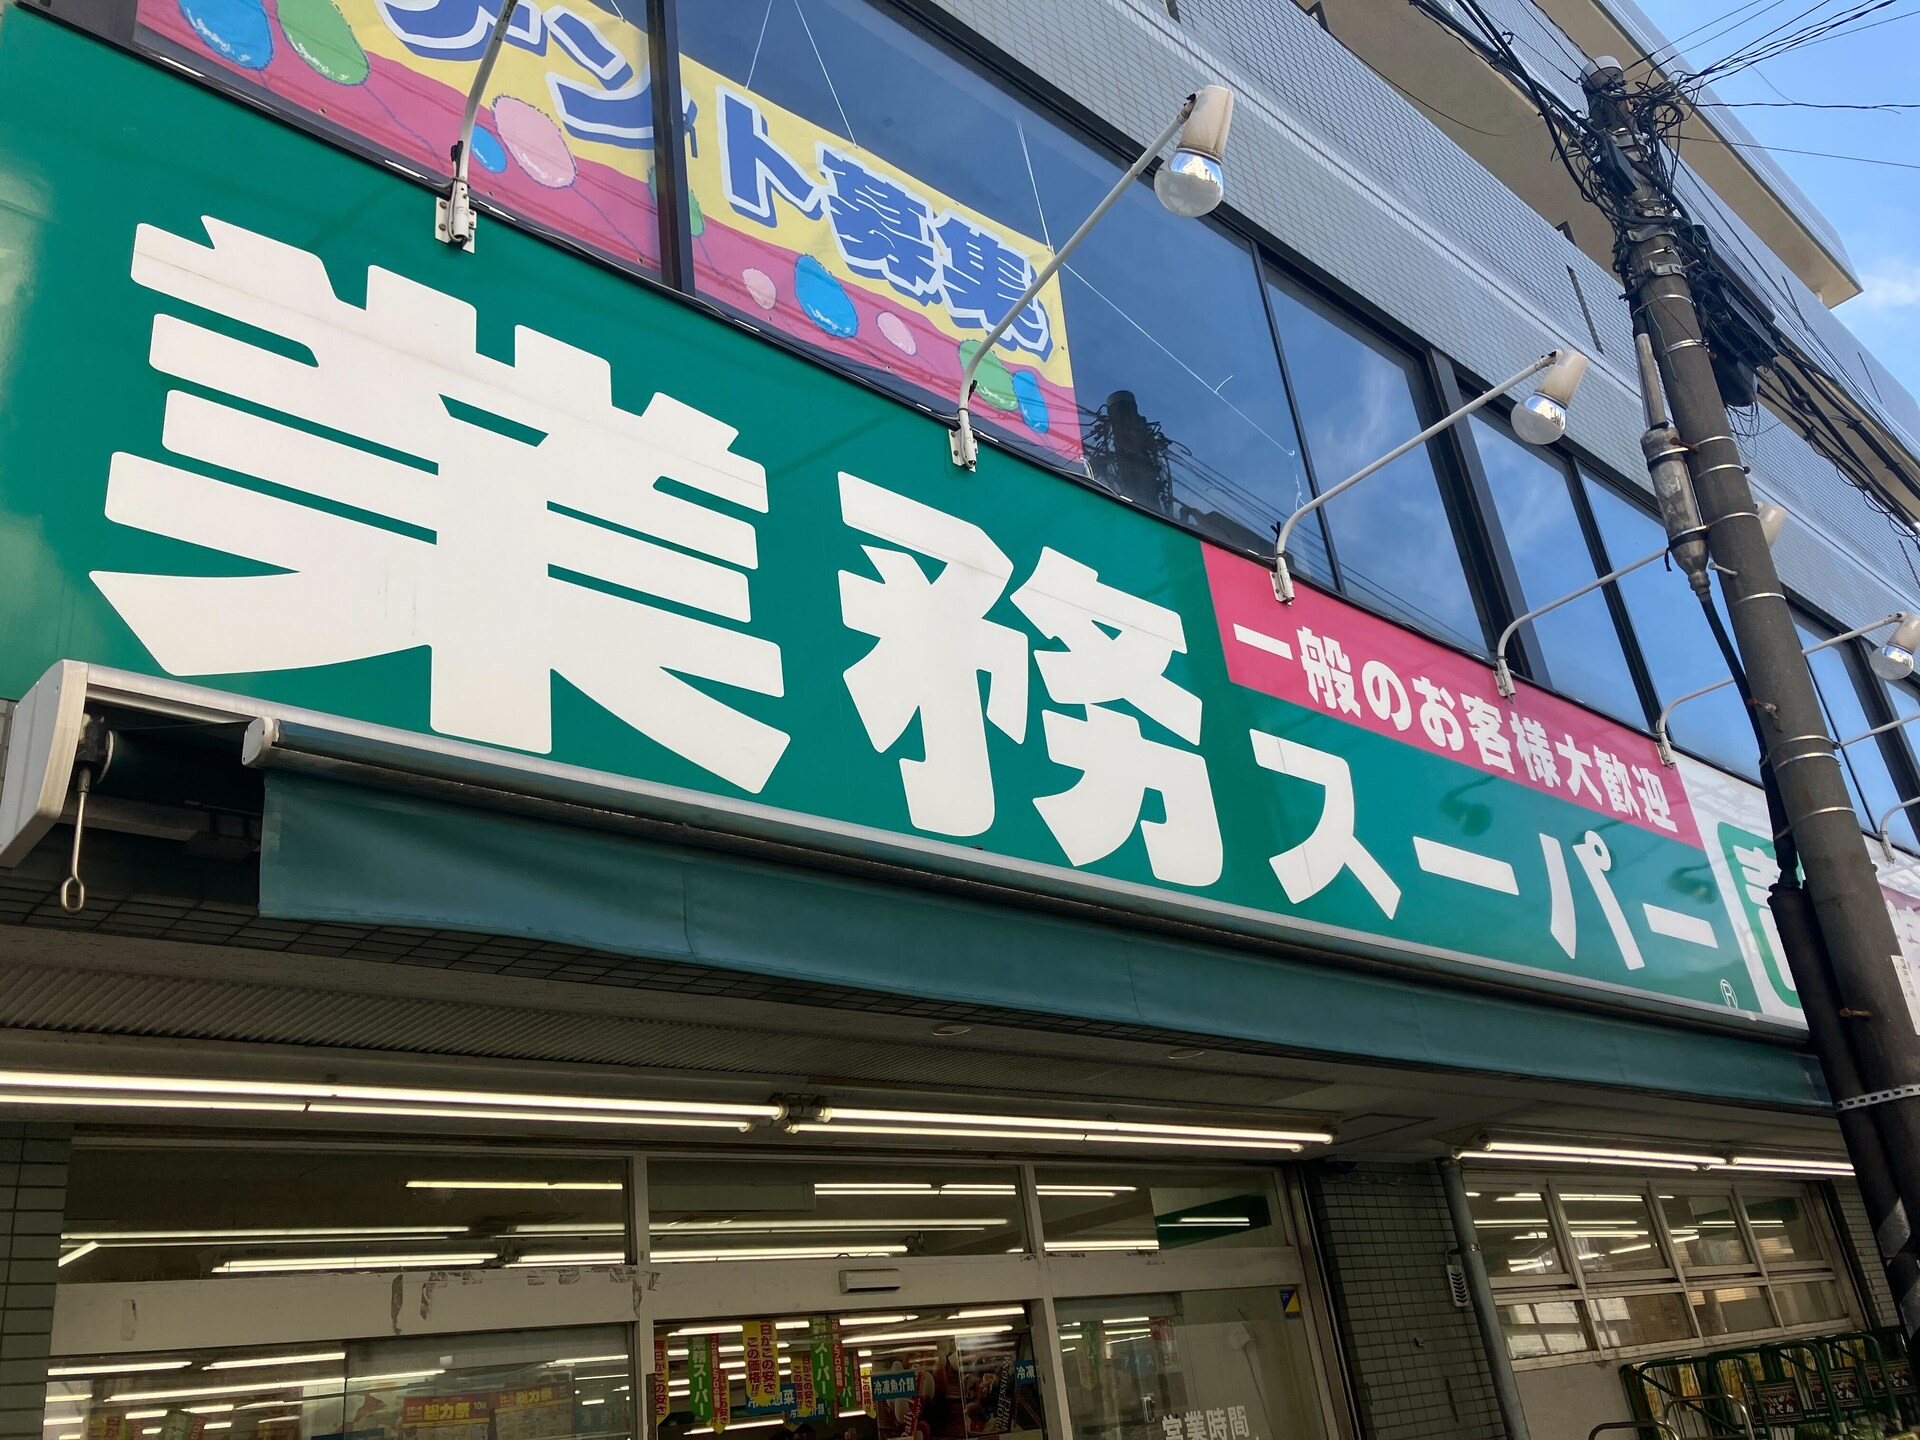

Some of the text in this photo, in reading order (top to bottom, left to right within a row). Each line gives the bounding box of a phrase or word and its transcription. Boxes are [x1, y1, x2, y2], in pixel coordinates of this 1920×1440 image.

[88, 215, 1717, 969] 業務スーパー
[1234, 623, 1678, 834] 一般のお客様大歓迎
[691, 1337, 709, 1416] 業務スーパー
[760, 1320, 776, 1395] 日がこの安さ
[1161, 1405, 1250, 1440] 営業時間
